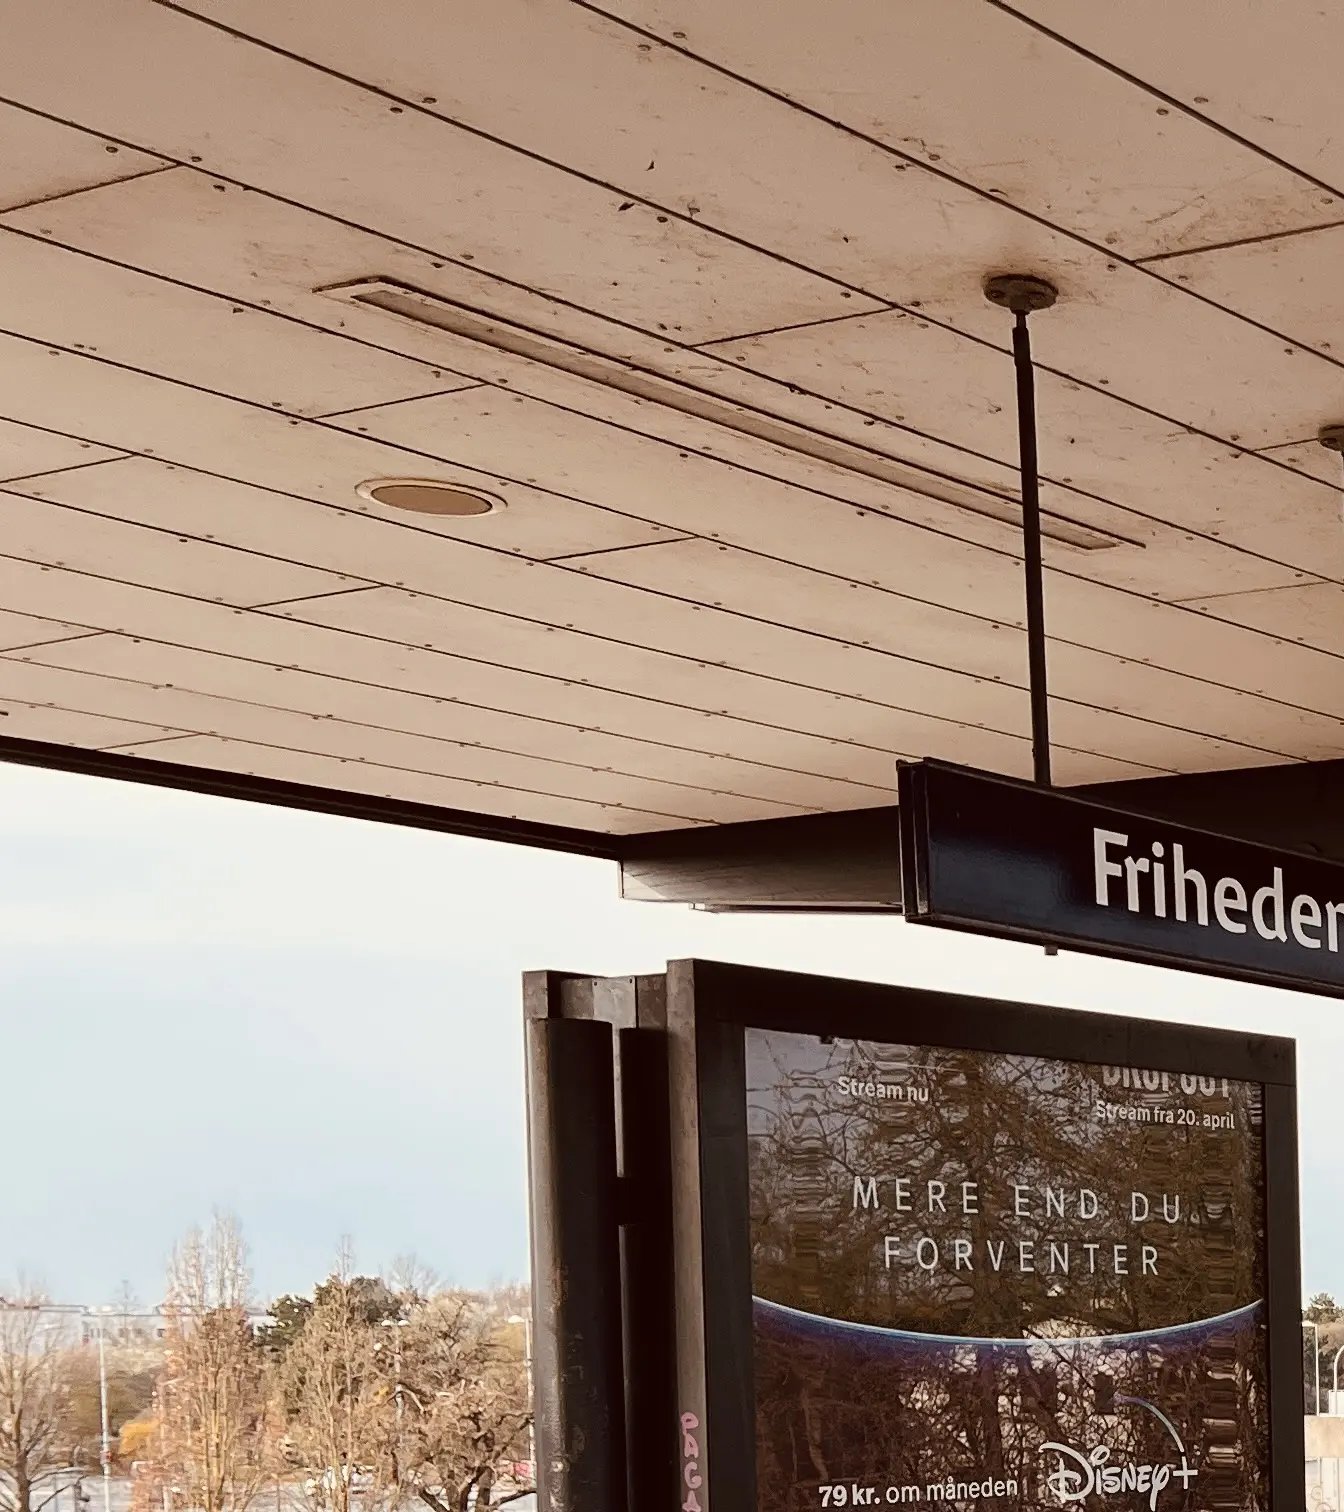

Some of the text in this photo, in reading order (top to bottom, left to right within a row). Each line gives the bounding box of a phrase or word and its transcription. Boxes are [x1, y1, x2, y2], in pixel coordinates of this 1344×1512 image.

[838, 1075, 929, 1102] Stream nu
[1096, 1100, 1236, 1131] Stream fra 20. april
[853, 1175, 1179, 1224] MERE END DU
[884, 1236, 1159, 1276] FORVENTER
[818, 1476, 1018, 1508] 79 kr. om måneden
